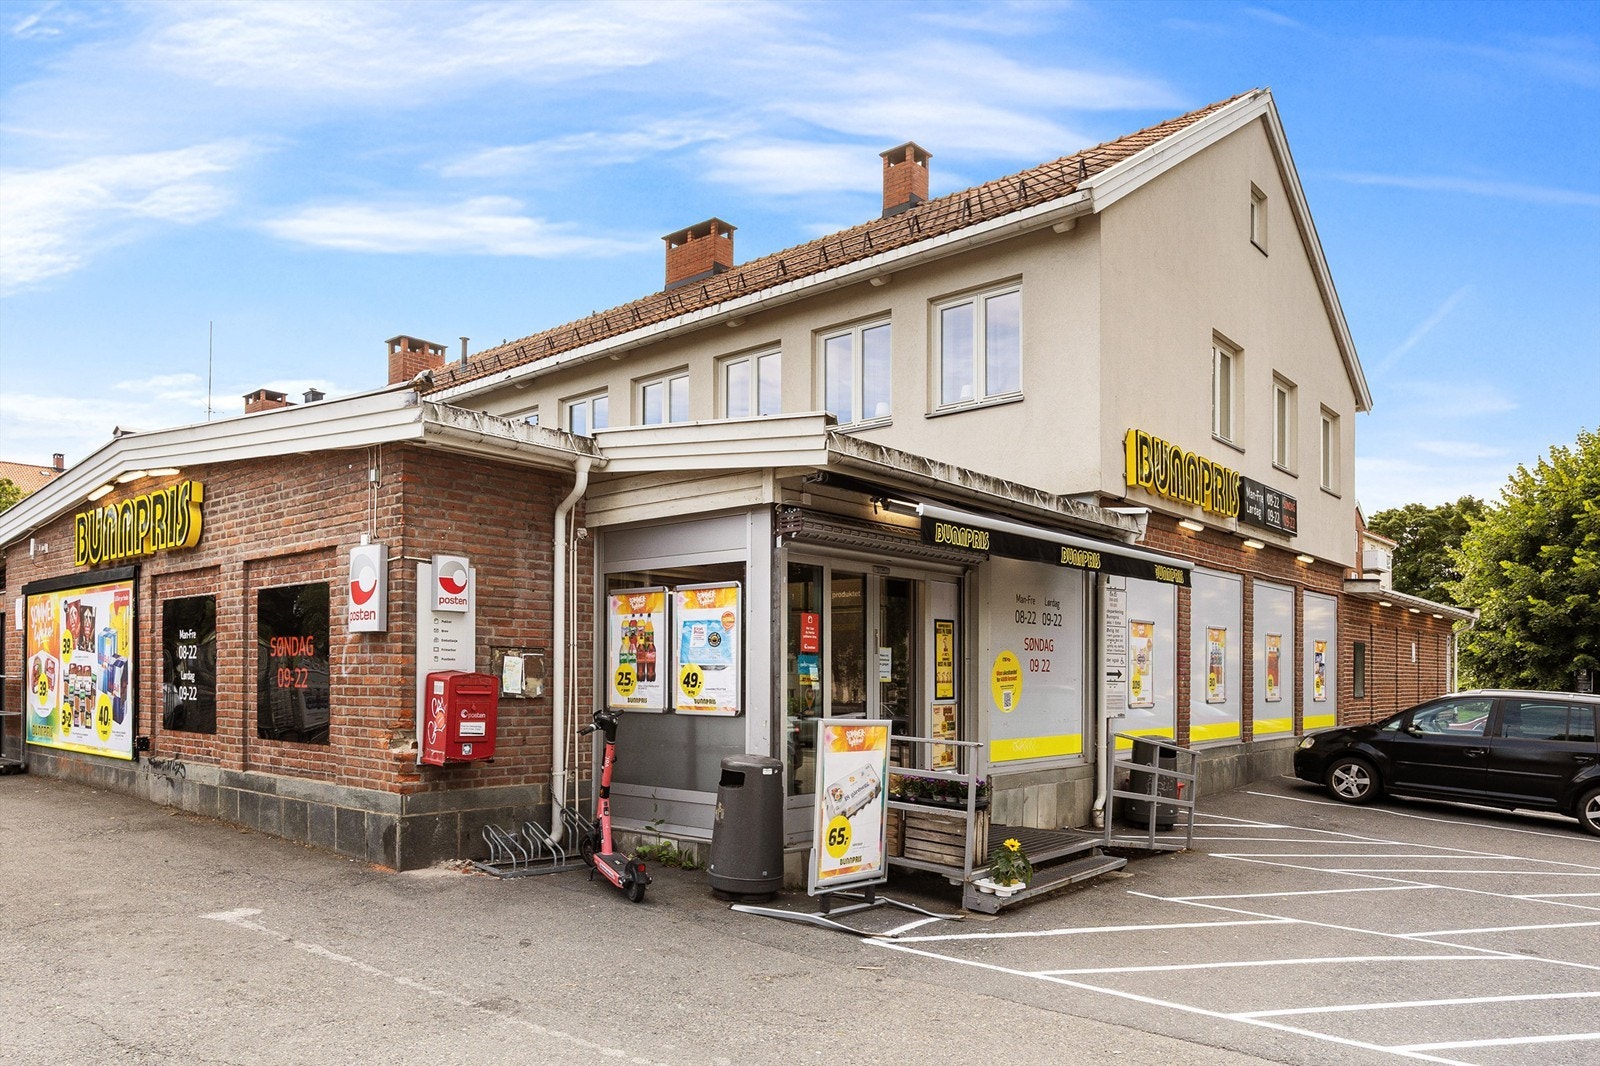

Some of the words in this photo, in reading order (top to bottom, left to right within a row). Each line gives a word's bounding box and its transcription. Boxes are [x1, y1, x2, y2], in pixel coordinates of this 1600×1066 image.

[1136, 429, 1240, 518] BUNNPRIS
[1266, 493, 1280, 509] 08-22
[75, 480, 194, 566] BUNNPRIS
[935, 522, 990, 550] BUNNPRIS
[1060, 546, 1101, 570] BUNNPRIS
[438, 596, 468, 605] posten
[832, 591, 861, 599] produktet
[1044, 597, 1061, 610] Lørdag
[349, 609, 377, 622] posten
[1015, 609, 1037, 625] 08-22
[1042, 612, 1063, 627] 09-22
[270, 635, 315, 657] SØNDAG
[1023, 637, 1054, 652] SØNDAG
[178, 645, 198, 660] 08-22
[180, 671, 196, 683] Lørdag
[277, 667, 308, 689] 09-22
[178, 686, 198, 701] 09-22
[840, 855, 863, 866] BUNNPRIS
